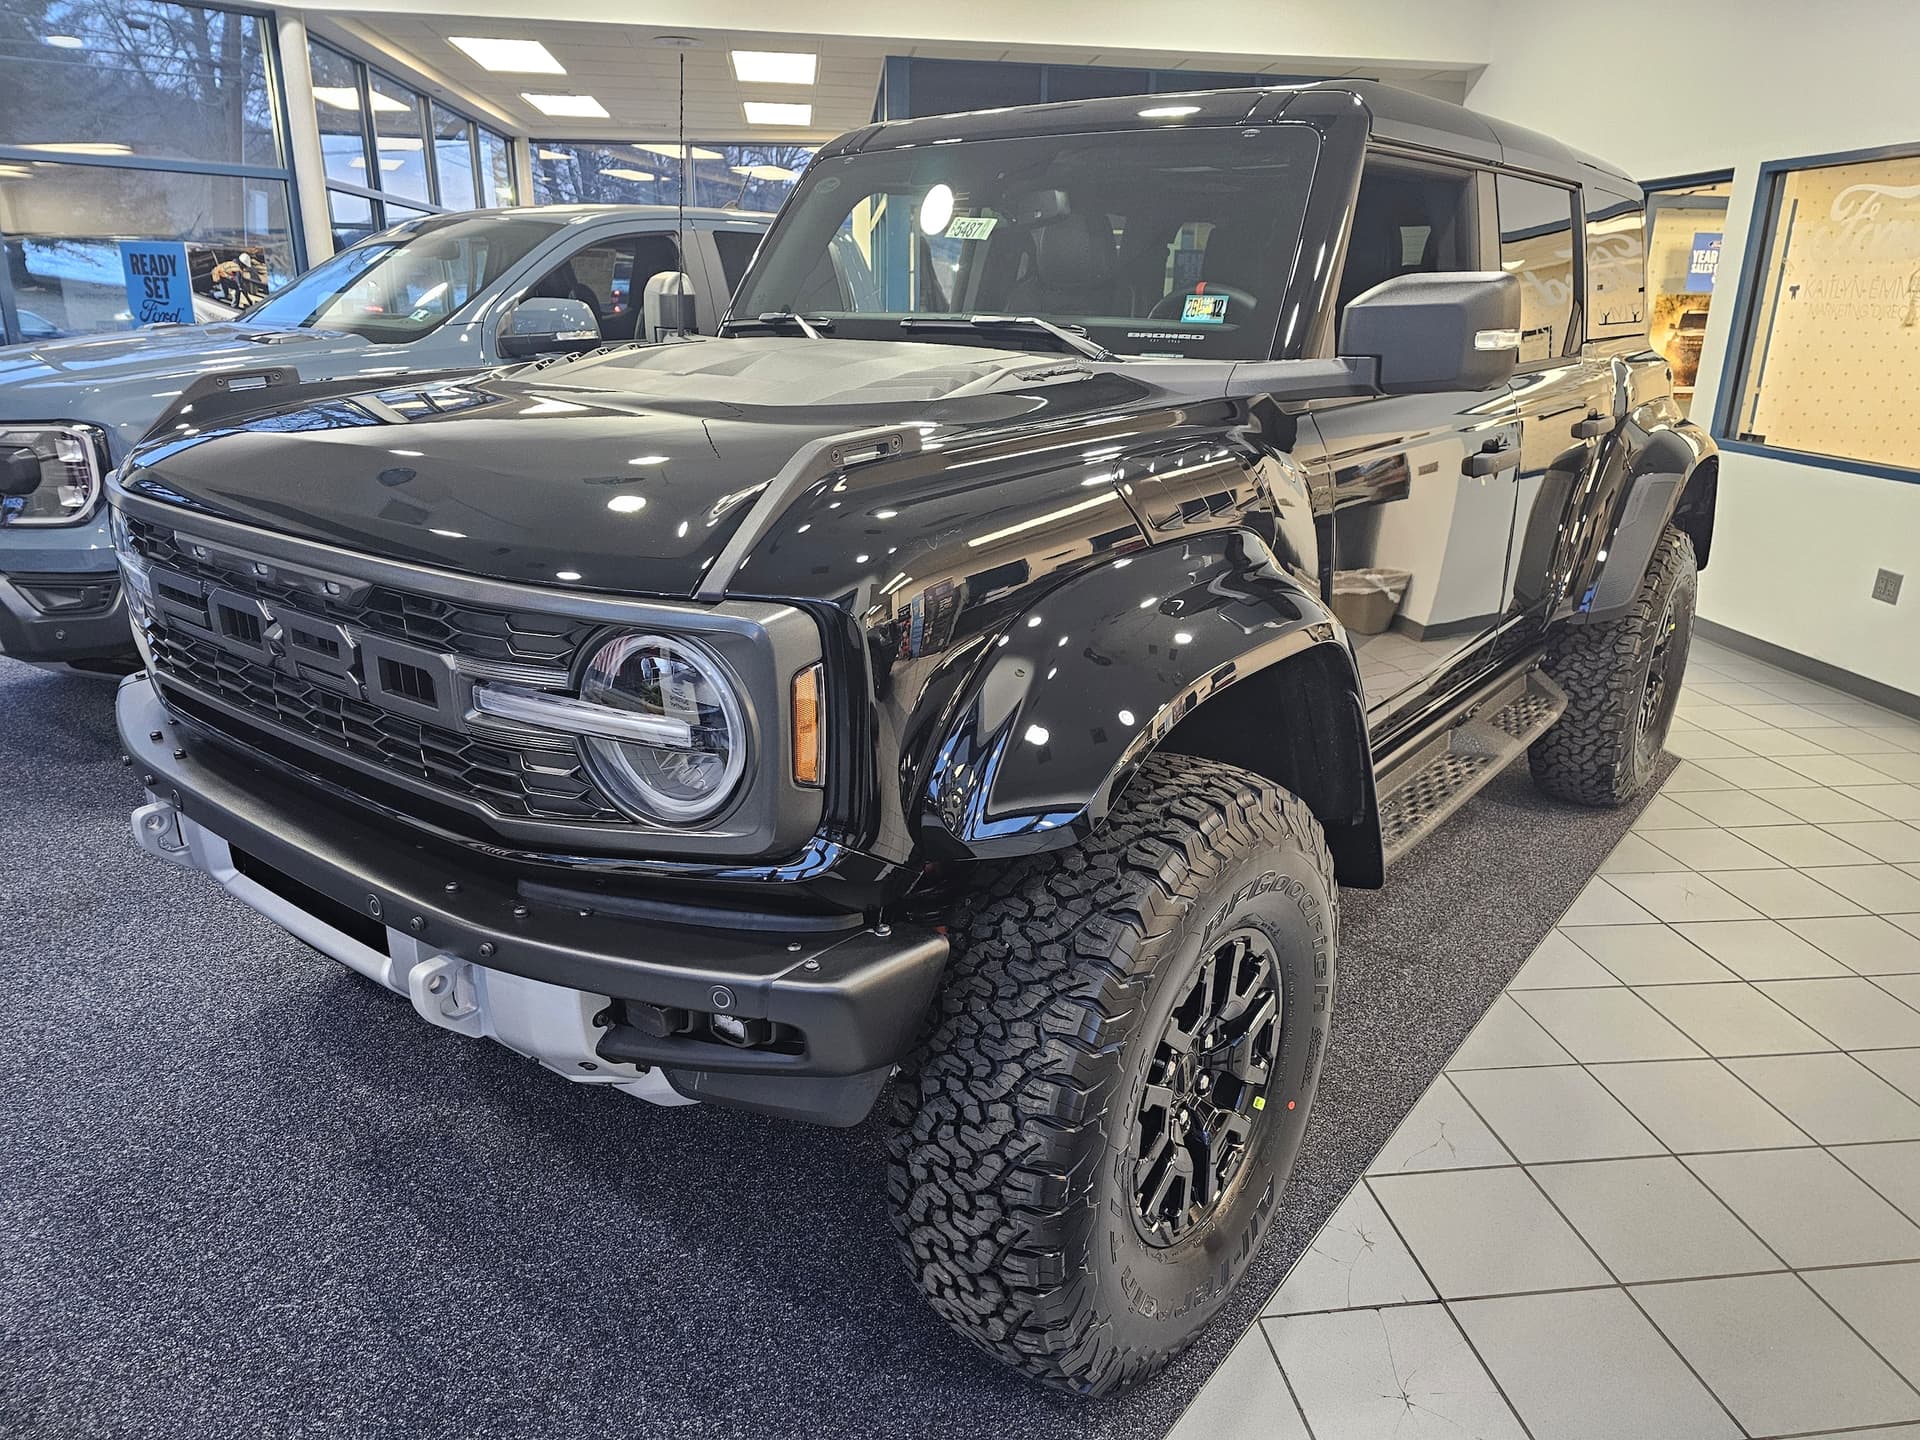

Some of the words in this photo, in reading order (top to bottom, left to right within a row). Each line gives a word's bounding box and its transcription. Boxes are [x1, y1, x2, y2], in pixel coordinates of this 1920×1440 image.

[129, 253, 177, 277] READY
[1692, 249, 1719, 264] YEAR
[1690, 263, 1713, 274] SALES
[144, 276, 170, 299] SET
[1803, 279, 1865, 299] KAITLYN
[139, 299, 181, 324] Ford
[1213, 299, 1224, 317] 12
[1127, 332, 1205, 341] BRONCO
[147, 565, 471, 735] FORD
